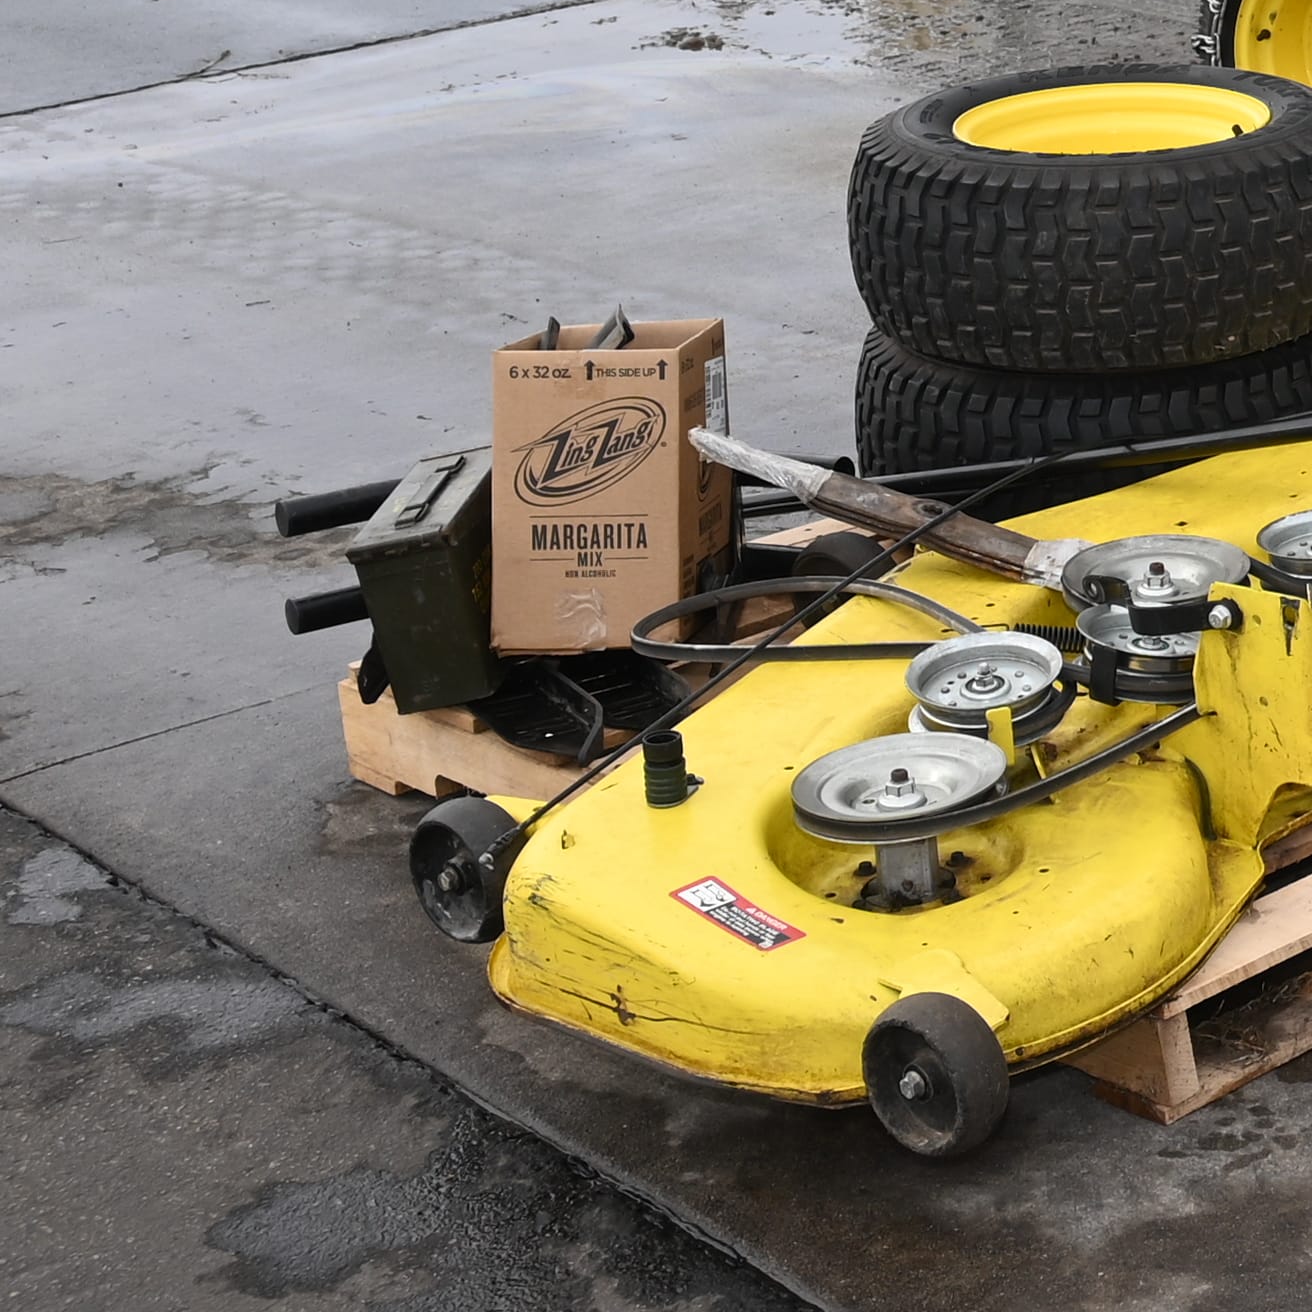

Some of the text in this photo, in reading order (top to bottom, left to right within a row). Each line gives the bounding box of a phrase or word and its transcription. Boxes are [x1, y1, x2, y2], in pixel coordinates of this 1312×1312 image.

[509, 365, 519, 379] 6
[522, 368, 530, 379] x
[533, 365, 550, 379] 32
[595, 367, 657, 378] THIS SIDE UP
[532, 417, 657, 485] Zing Zang
[531, 522, 648, 551] MARGARITA
[577, 551, 603, 568] MIX
